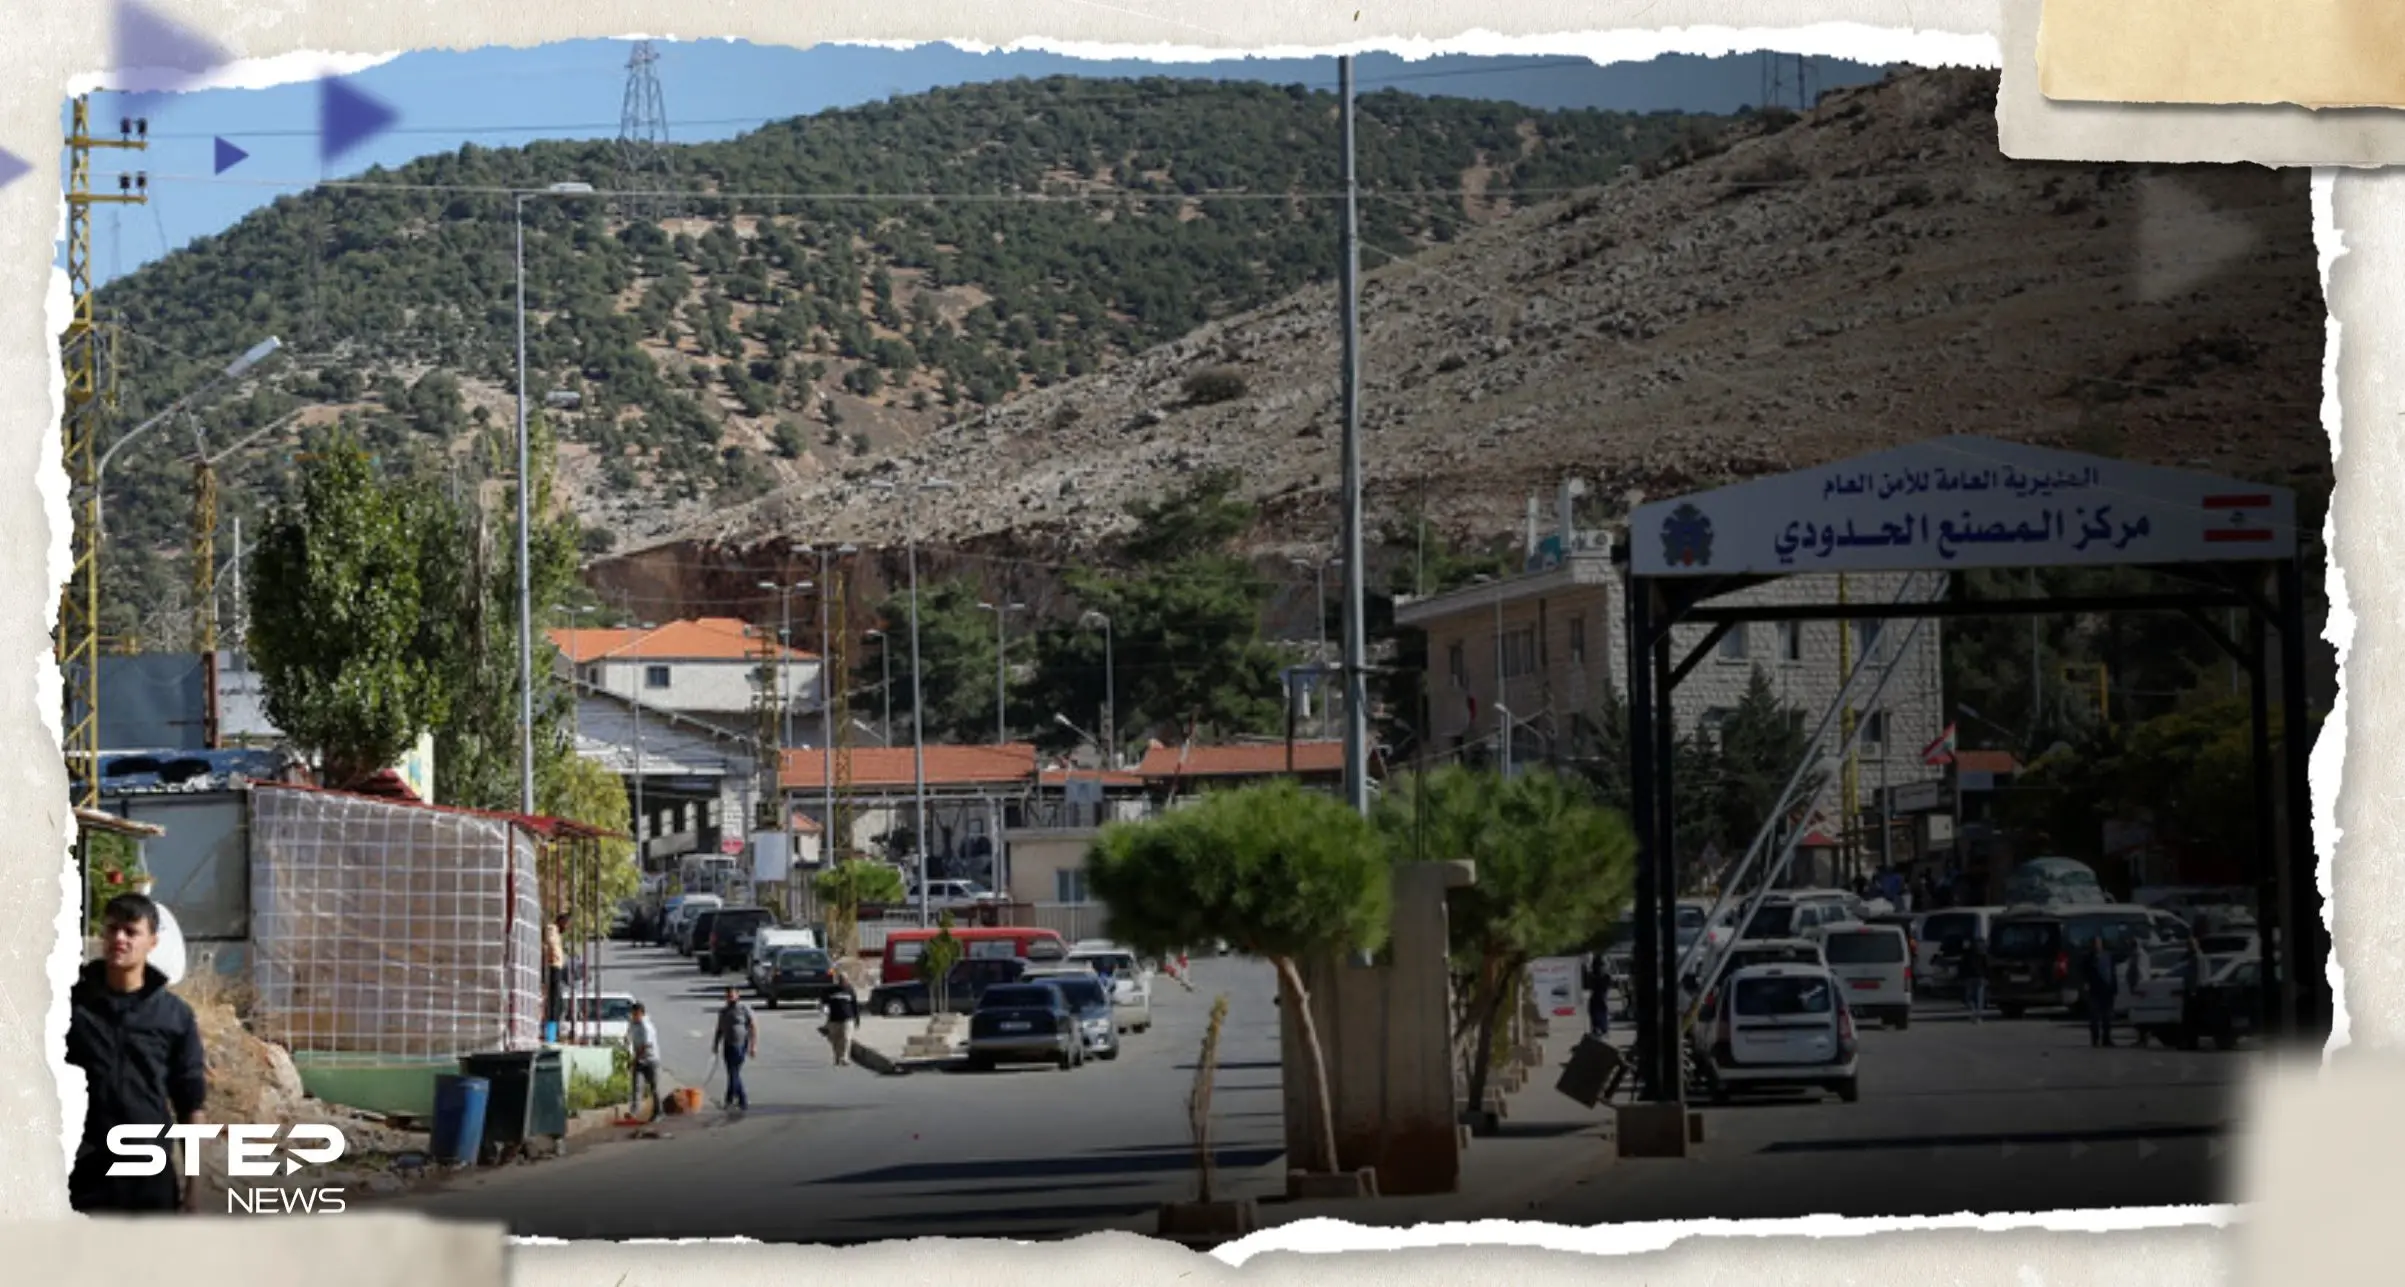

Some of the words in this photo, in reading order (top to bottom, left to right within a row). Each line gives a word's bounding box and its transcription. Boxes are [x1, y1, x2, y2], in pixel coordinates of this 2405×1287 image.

[1823, 471, 1873, 500] العام
[1935, 467, 1998, 492] العامة
[1774, 511, 1929, 564] الحدودي
[1936, 507, 2065, 559] المصنع
[2072, 503, 2151, 551] مركز
